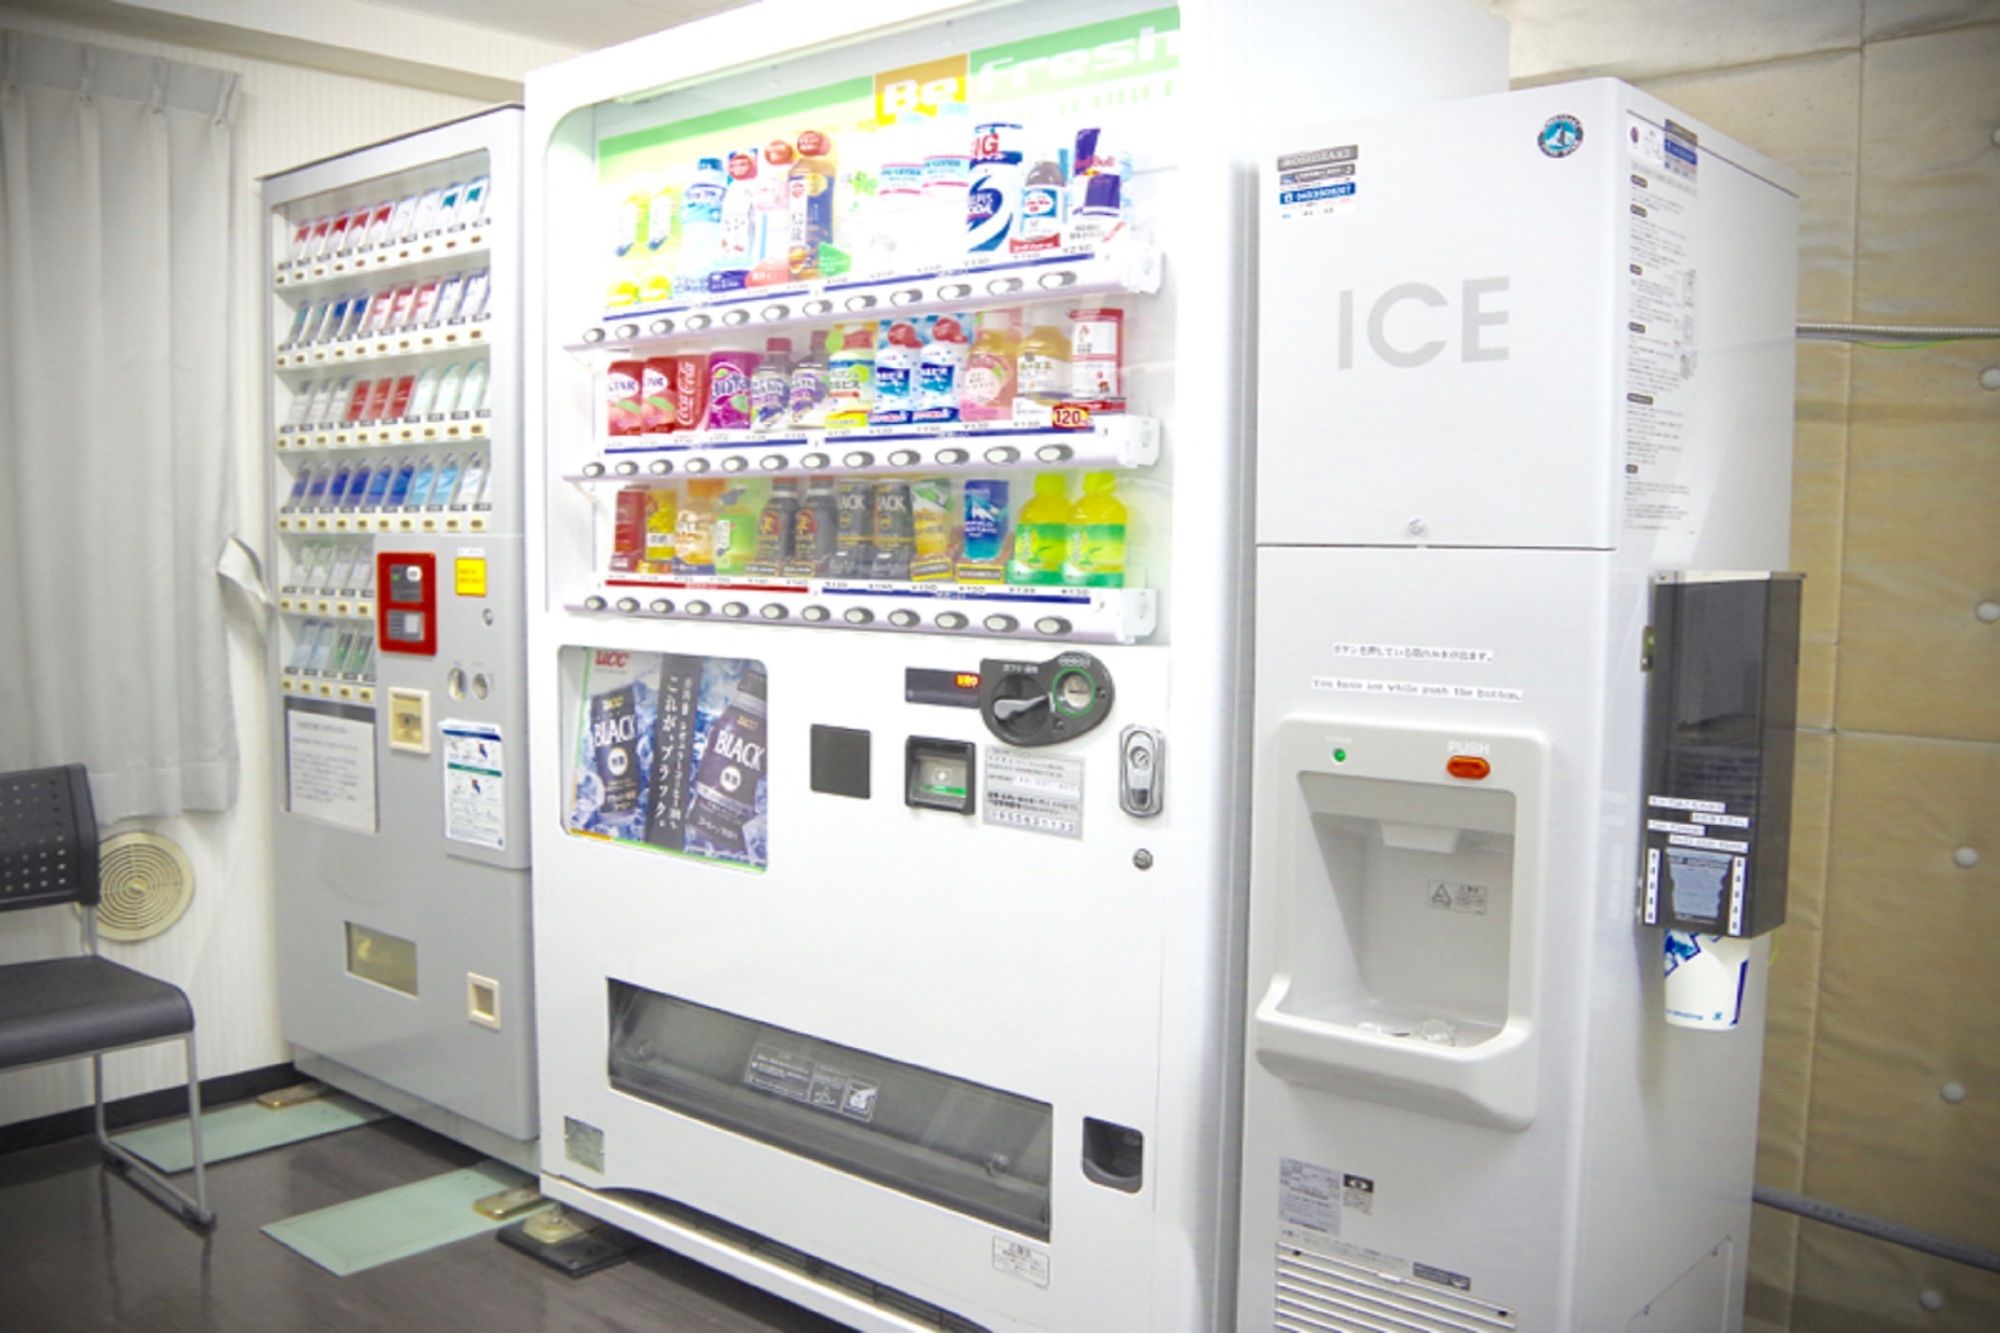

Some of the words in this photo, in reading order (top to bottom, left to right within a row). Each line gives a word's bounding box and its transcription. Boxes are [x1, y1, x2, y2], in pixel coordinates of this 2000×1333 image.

[884, 78, 957, 117] Be
[1337, 275, 1510, 370] ICE
[1054, 411, 1082, 424] 120
[1313, 678, 1333, 688] You
[1337, 680, 1362, 689] have
[1387, 683, 1418, 694] while
[1454, 687, 1473, 697] the
[714, 729, 766, 772] BLACK
[1447, 739, 1491, 755] PUSH
